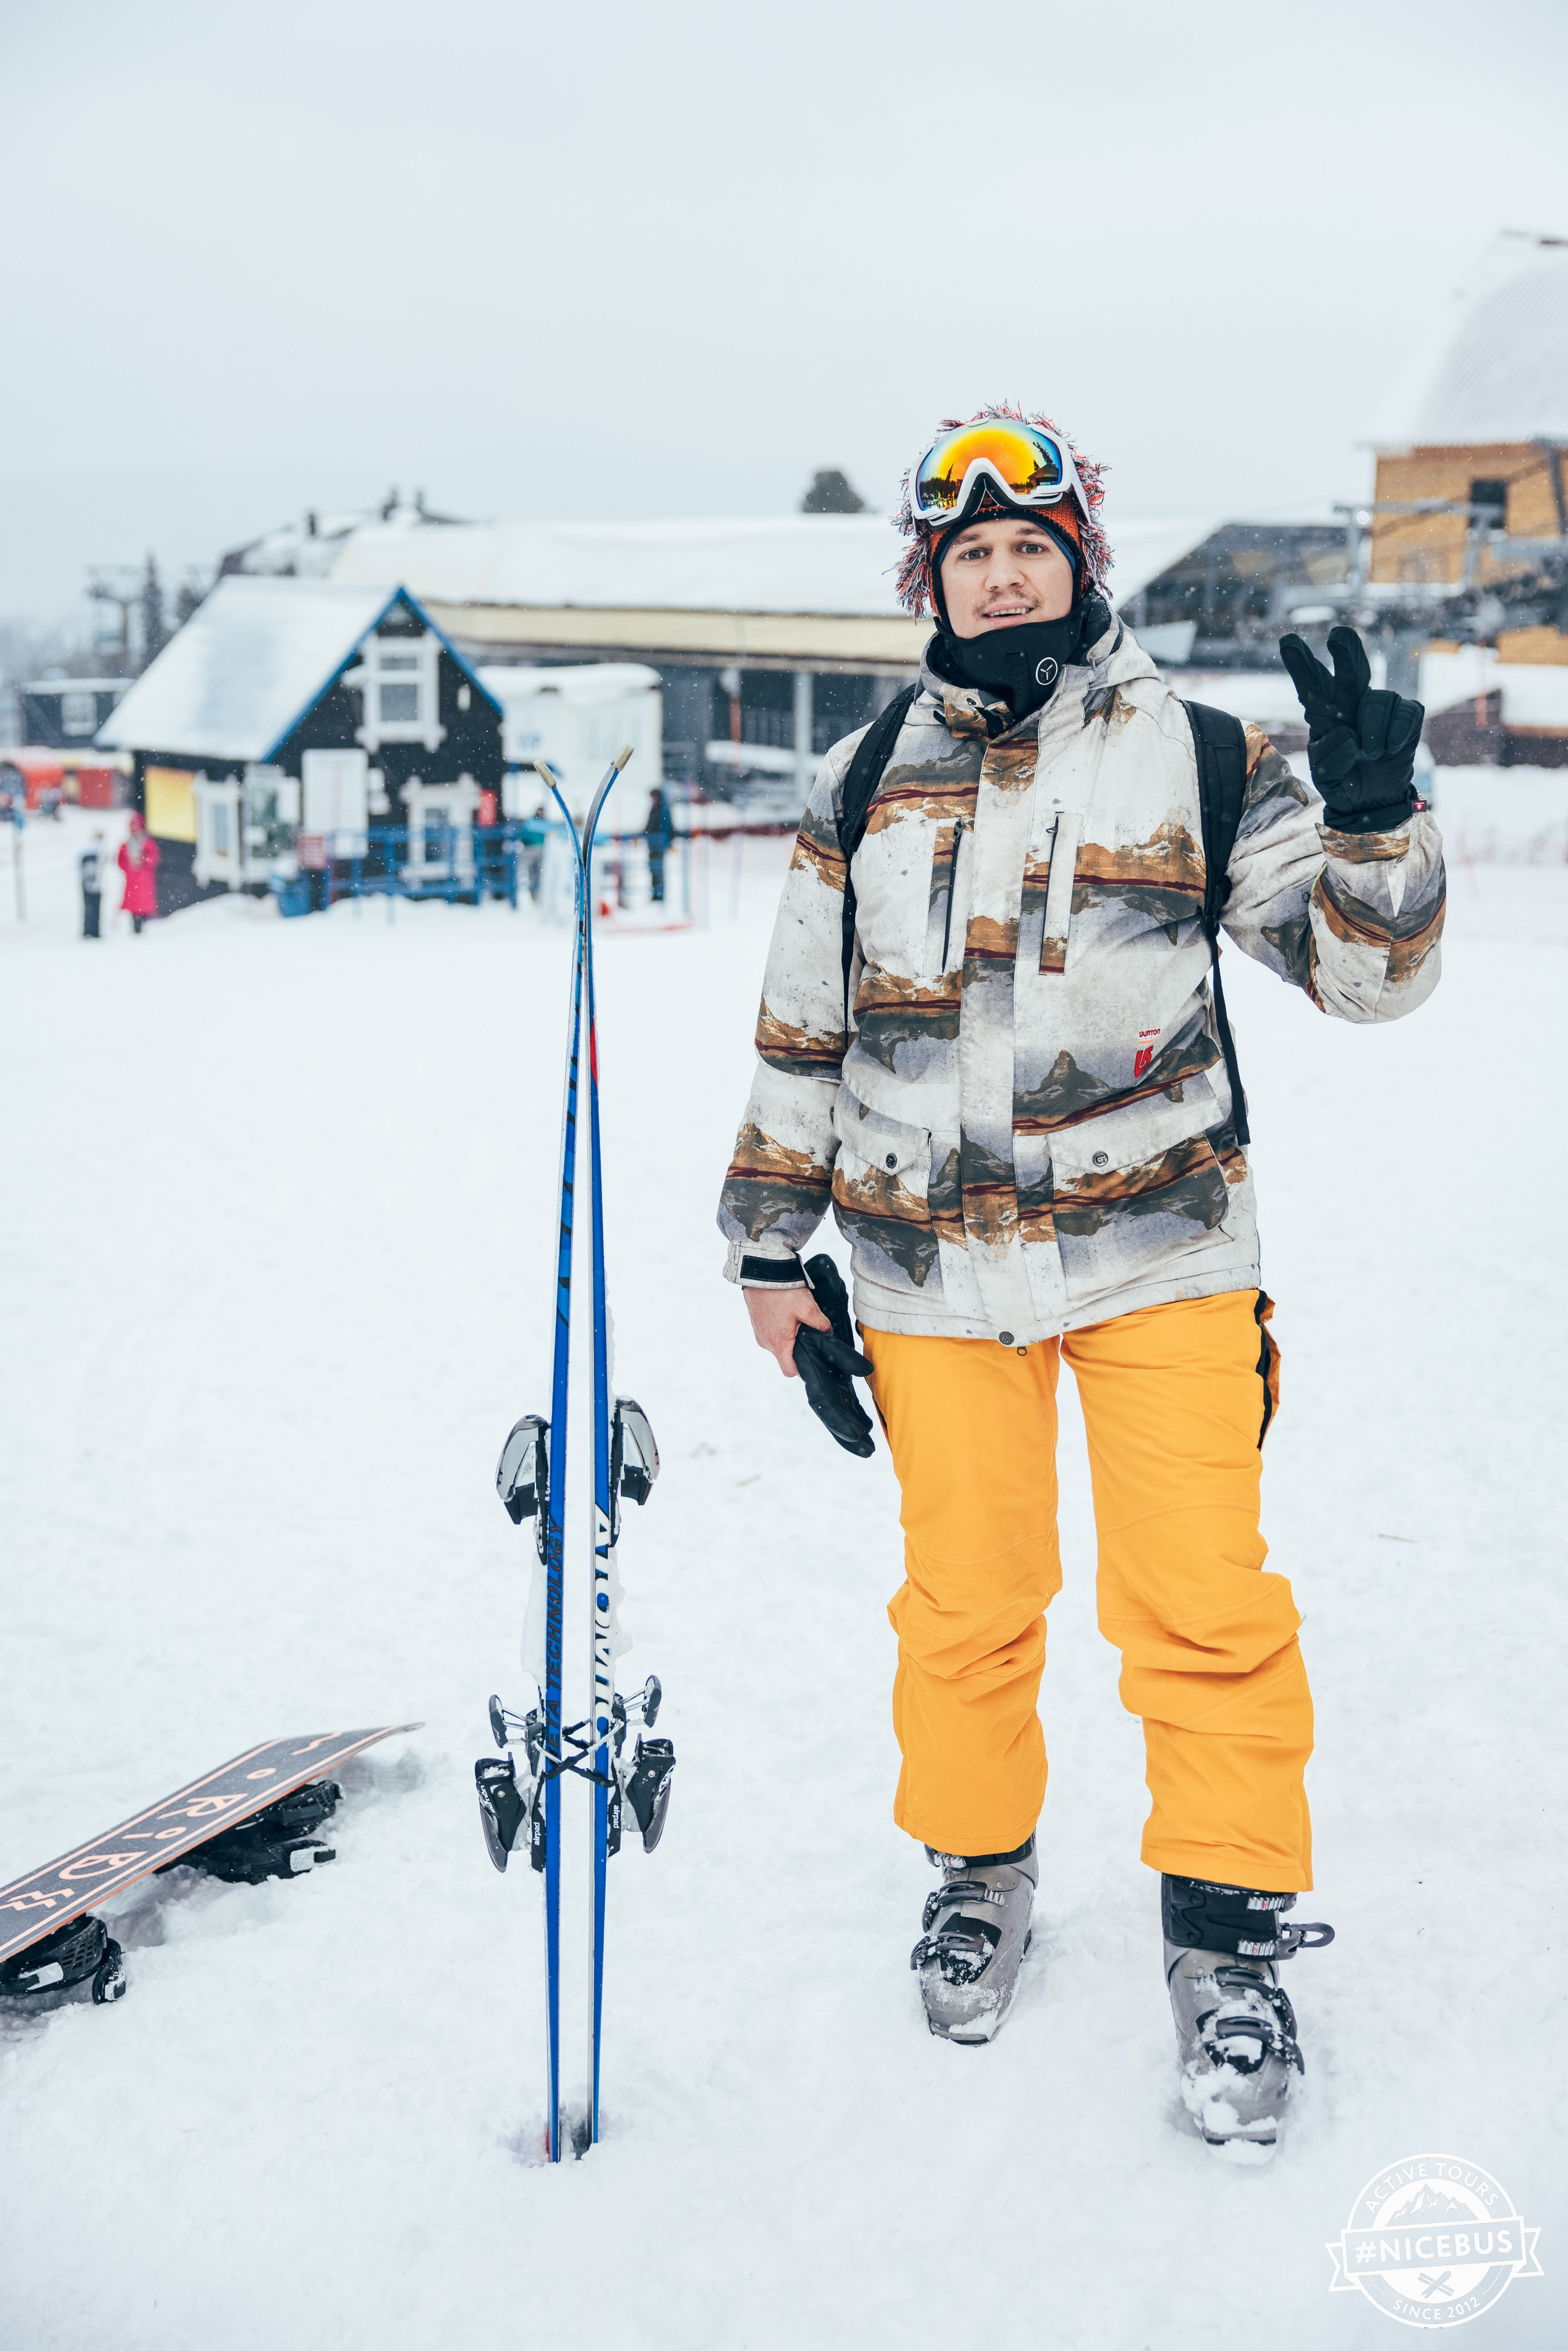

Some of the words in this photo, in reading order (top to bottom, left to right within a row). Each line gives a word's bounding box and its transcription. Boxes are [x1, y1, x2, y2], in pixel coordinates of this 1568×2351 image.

[1139, 1028, 1161, 1038] BURTON
[547, 1514, 563, 1689] TECHNOLOGY
[595, 1503, 611, 1745] ATOMIC
[611, 1805, 620, 1828] airpad
[533, 1822, 541, 1846] airpad
